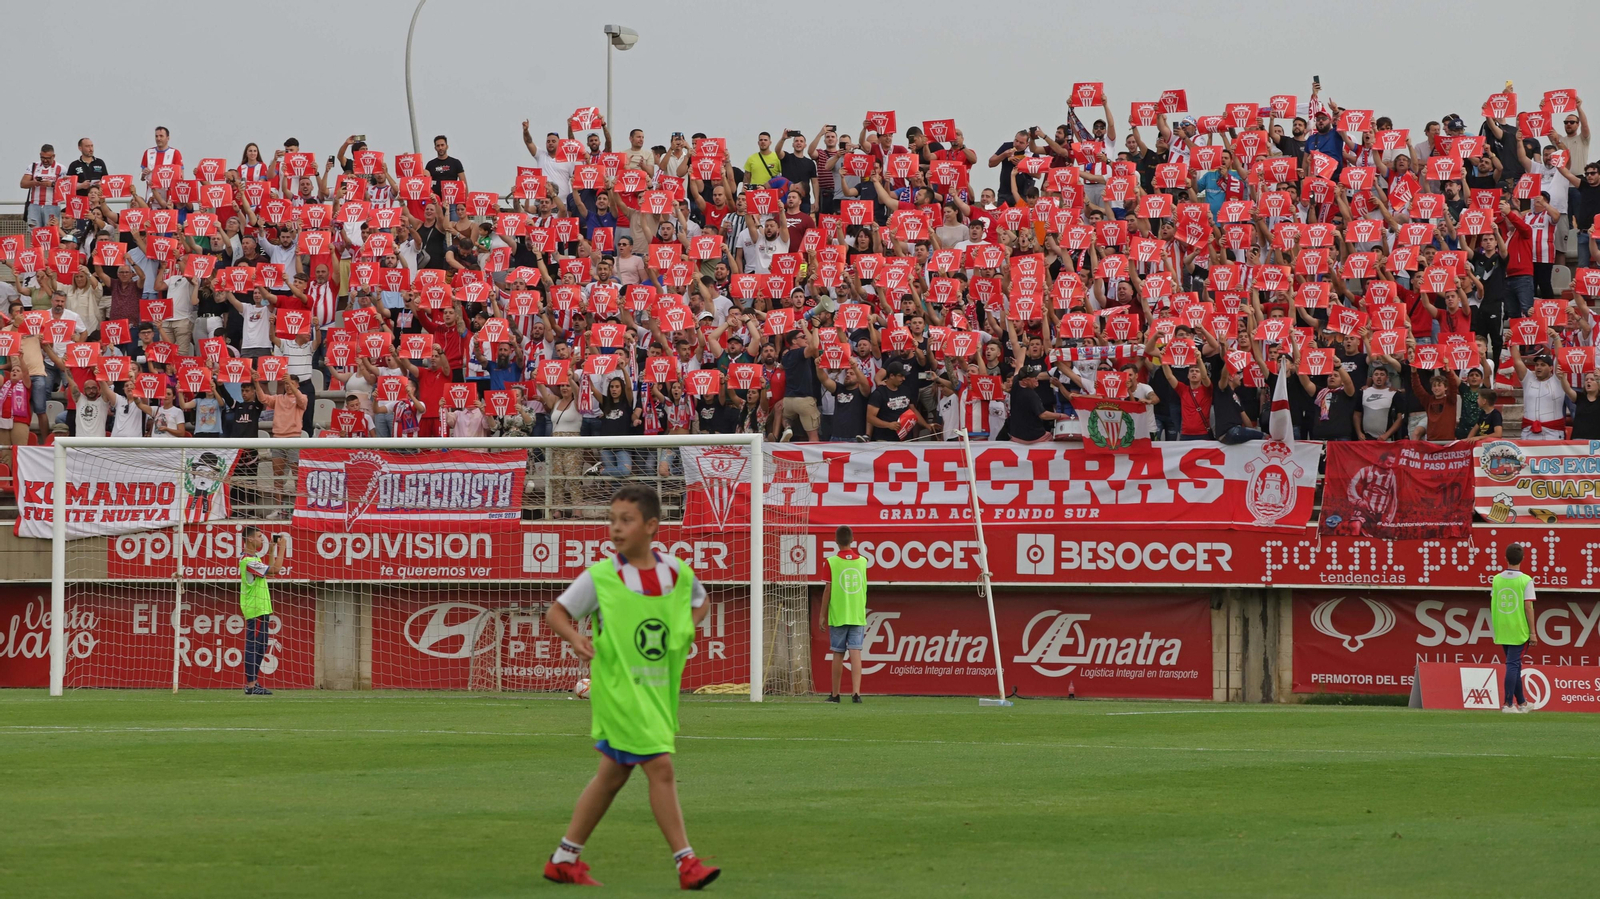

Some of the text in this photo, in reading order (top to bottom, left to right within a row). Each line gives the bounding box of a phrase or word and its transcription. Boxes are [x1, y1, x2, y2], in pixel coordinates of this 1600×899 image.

[1409, 460, 1422, 469] UN
[1424, 462, 1446, 471] PASO
[1531, 458, 1560, 474] LOS
[763, 447, 1225, 507] ALGECIRAS
[306, 470, 514, 511] SOY ALGECIRISTA
[100, 508, 170, 523] NUEVA
[880, 508, 939, 520] GRADA
[994, 508, 1055, 519] FONDO
[1064, 507, 1100, 519] SUR
[565, 540, 728, 570] BESCER
[1061, 540, 1233, 571] BESOCCER
[198, 566, 240, 579] quere
[279, 566, 293, 576] er
[380, 565, 492, 579] te queremos ver
[1319, 571, 1406, 584] tendencias
[1479, 573, 1568, 585] tecias
[23, 595, 101, 630] Veta
[133, 603, 282, 635] El Cereo
[1415, 600, 1600, 648] SSAGY
[176, 637, 243, 673] Rojo
[890, 664, 1004, 678] Logística Integral en transpor
[1080, 667, 1198, 680] Logística Integral en transporte
[1311, 673, 1373, 685] PERMOTOR
[1376, 675, 1398, 685] DEL
[1554, 678, 1591, 689] torres
[1464, 688, 1493, 705] AXA
[1561, 693, 1595, 704] agencia
